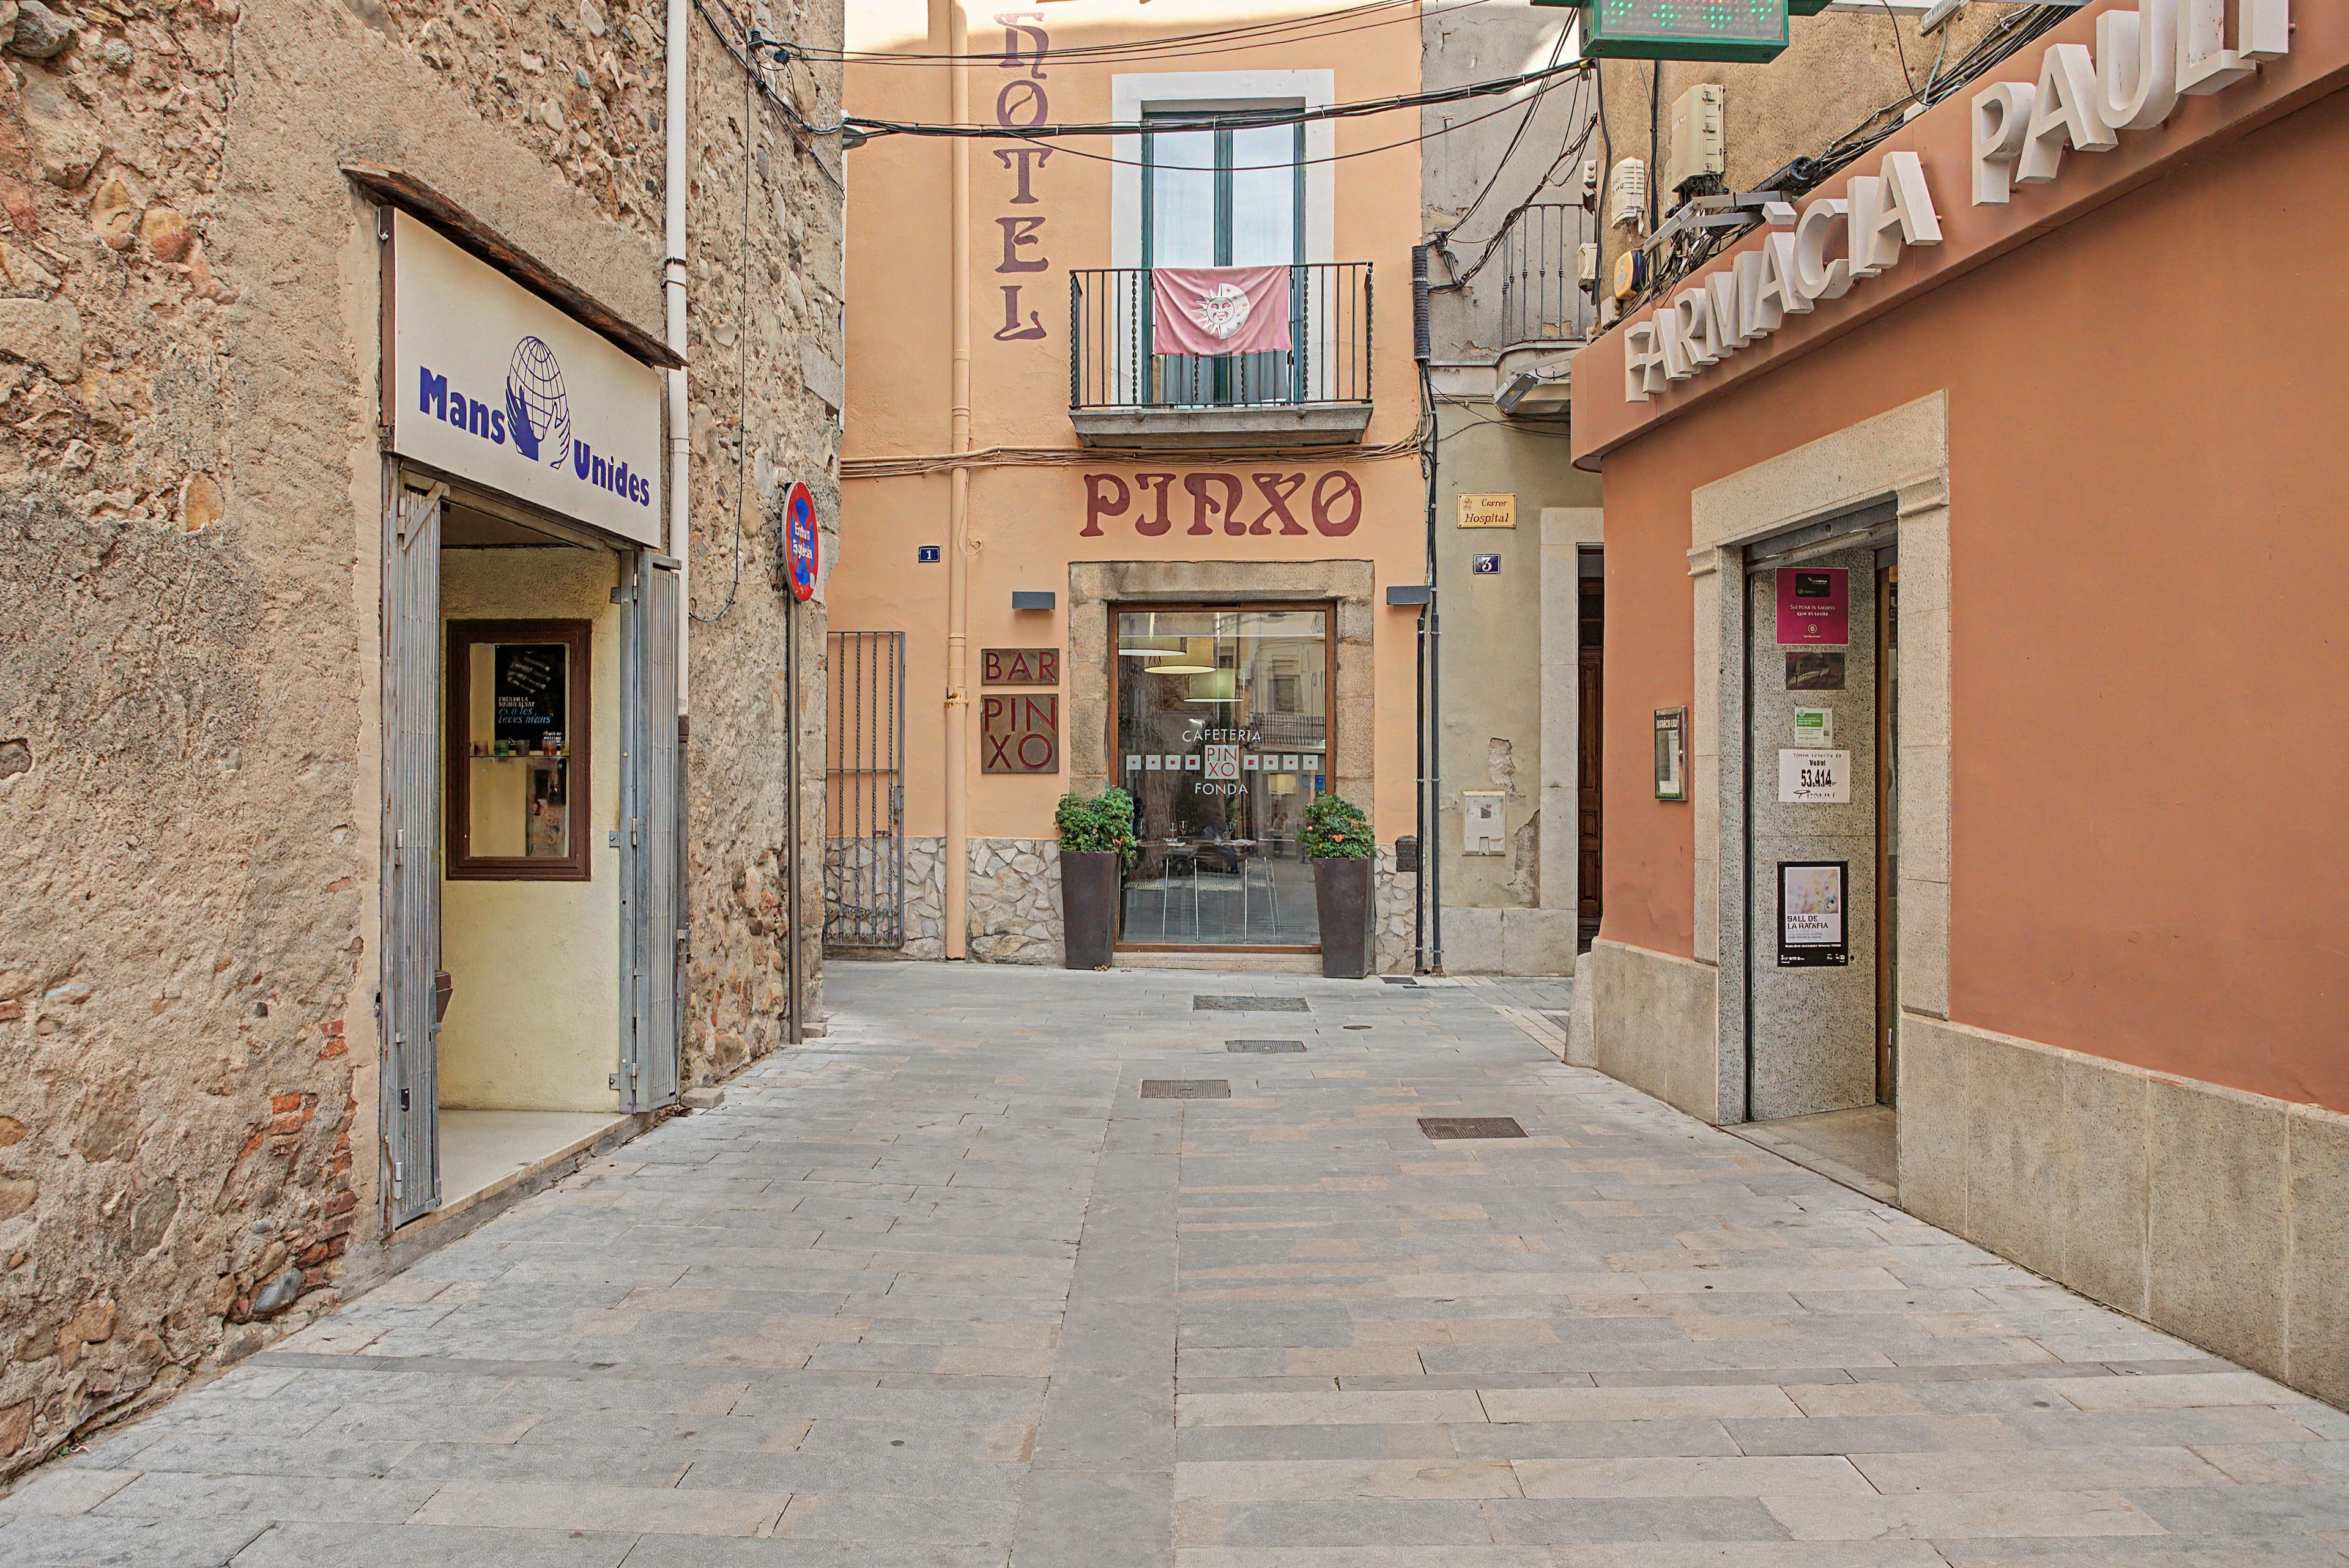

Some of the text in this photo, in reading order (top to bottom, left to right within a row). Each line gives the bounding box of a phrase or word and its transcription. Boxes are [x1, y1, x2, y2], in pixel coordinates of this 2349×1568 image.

[993, 12, 1053, 341] HOTEL
[1625, 152, 1943, 403] FARMÀCIA
[420, 365, 650, 507] Mans Unides
[1080, 470, 1362, 537] PINXO
[1482, 498, 1507, 507] Carrer
[1464, 513, 1508, 524] Hospital
[925, 550, 932, 560] 1
[1482, 557, 1492, 572] 3
[985, 652, 1056, 681] BAR
[984, 697, 1056, 733] PIN
[1181, 728, 1261, 742] CAFETERIA
[987, 734, 1052, 769] XO
[1206, 747, 1238, 762] PIN
[1208, 762, 1236, 777] XO
[1801, 769, 1832, 788] 53.414
[1195, 783, 1249, 795] FONDA
